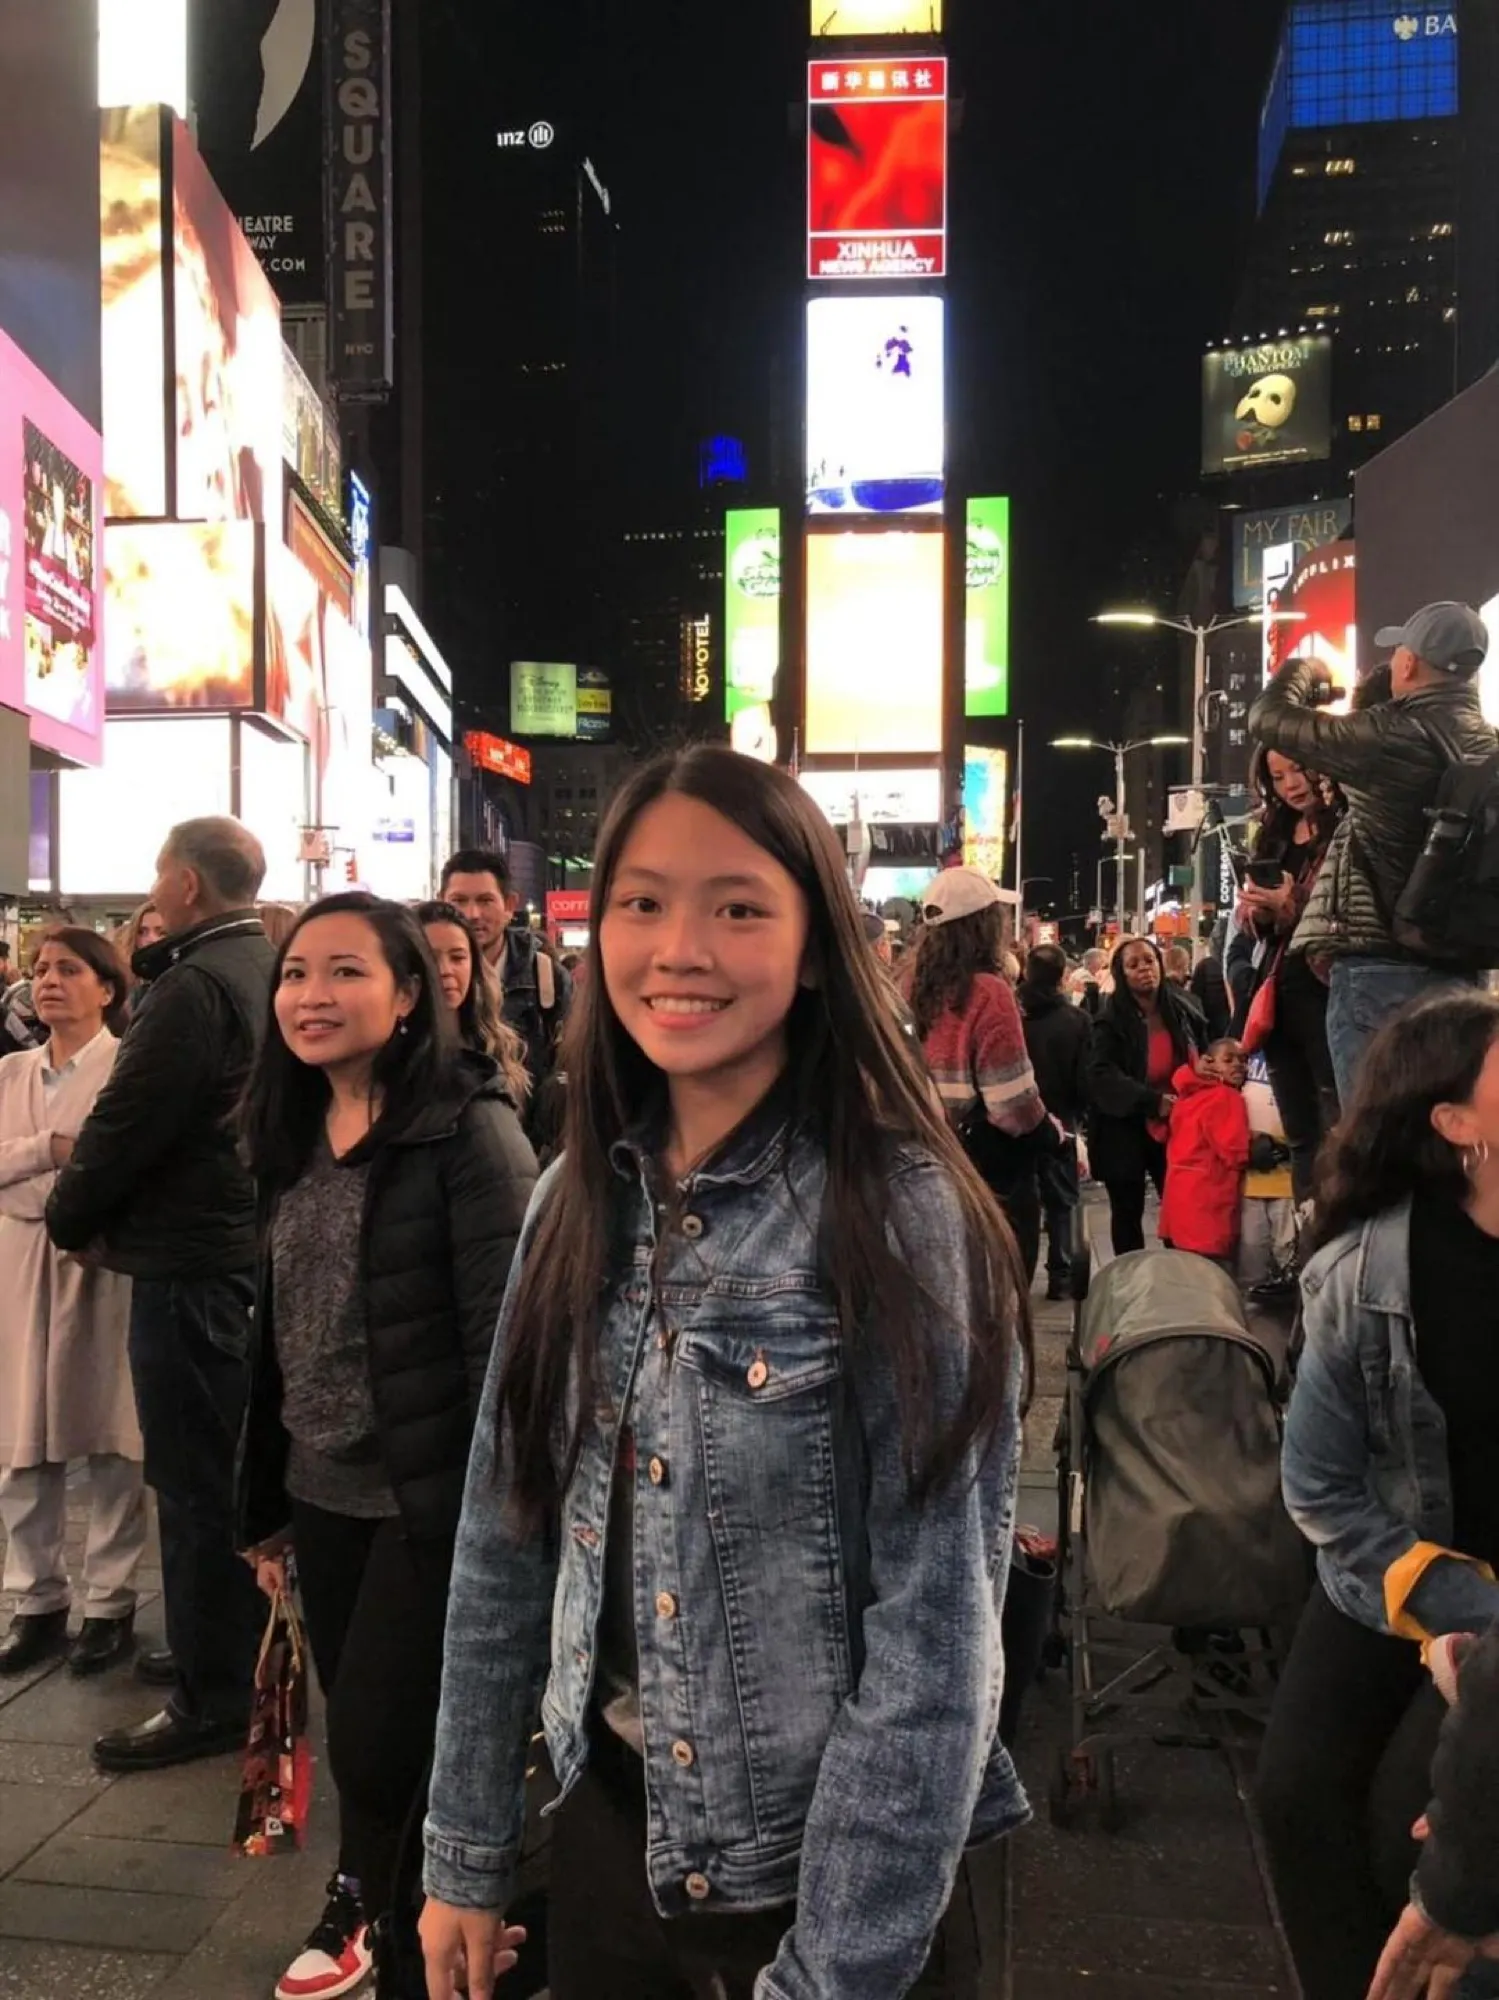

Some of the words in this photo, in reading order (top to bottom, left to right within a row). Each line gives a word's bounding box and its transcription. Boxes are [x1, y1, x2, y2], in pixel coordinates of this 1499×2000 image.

[338, 30, 380, 310] SQUARE
[836, 239, 918, 260] XINHUA
[1223, 346, 1309, 373] PHANTOM
[1243, 516, 1281, 543] MY
[1287, 508, 1338, 541] FAIR
[693, 612, 710, 702] NOVOTEL
